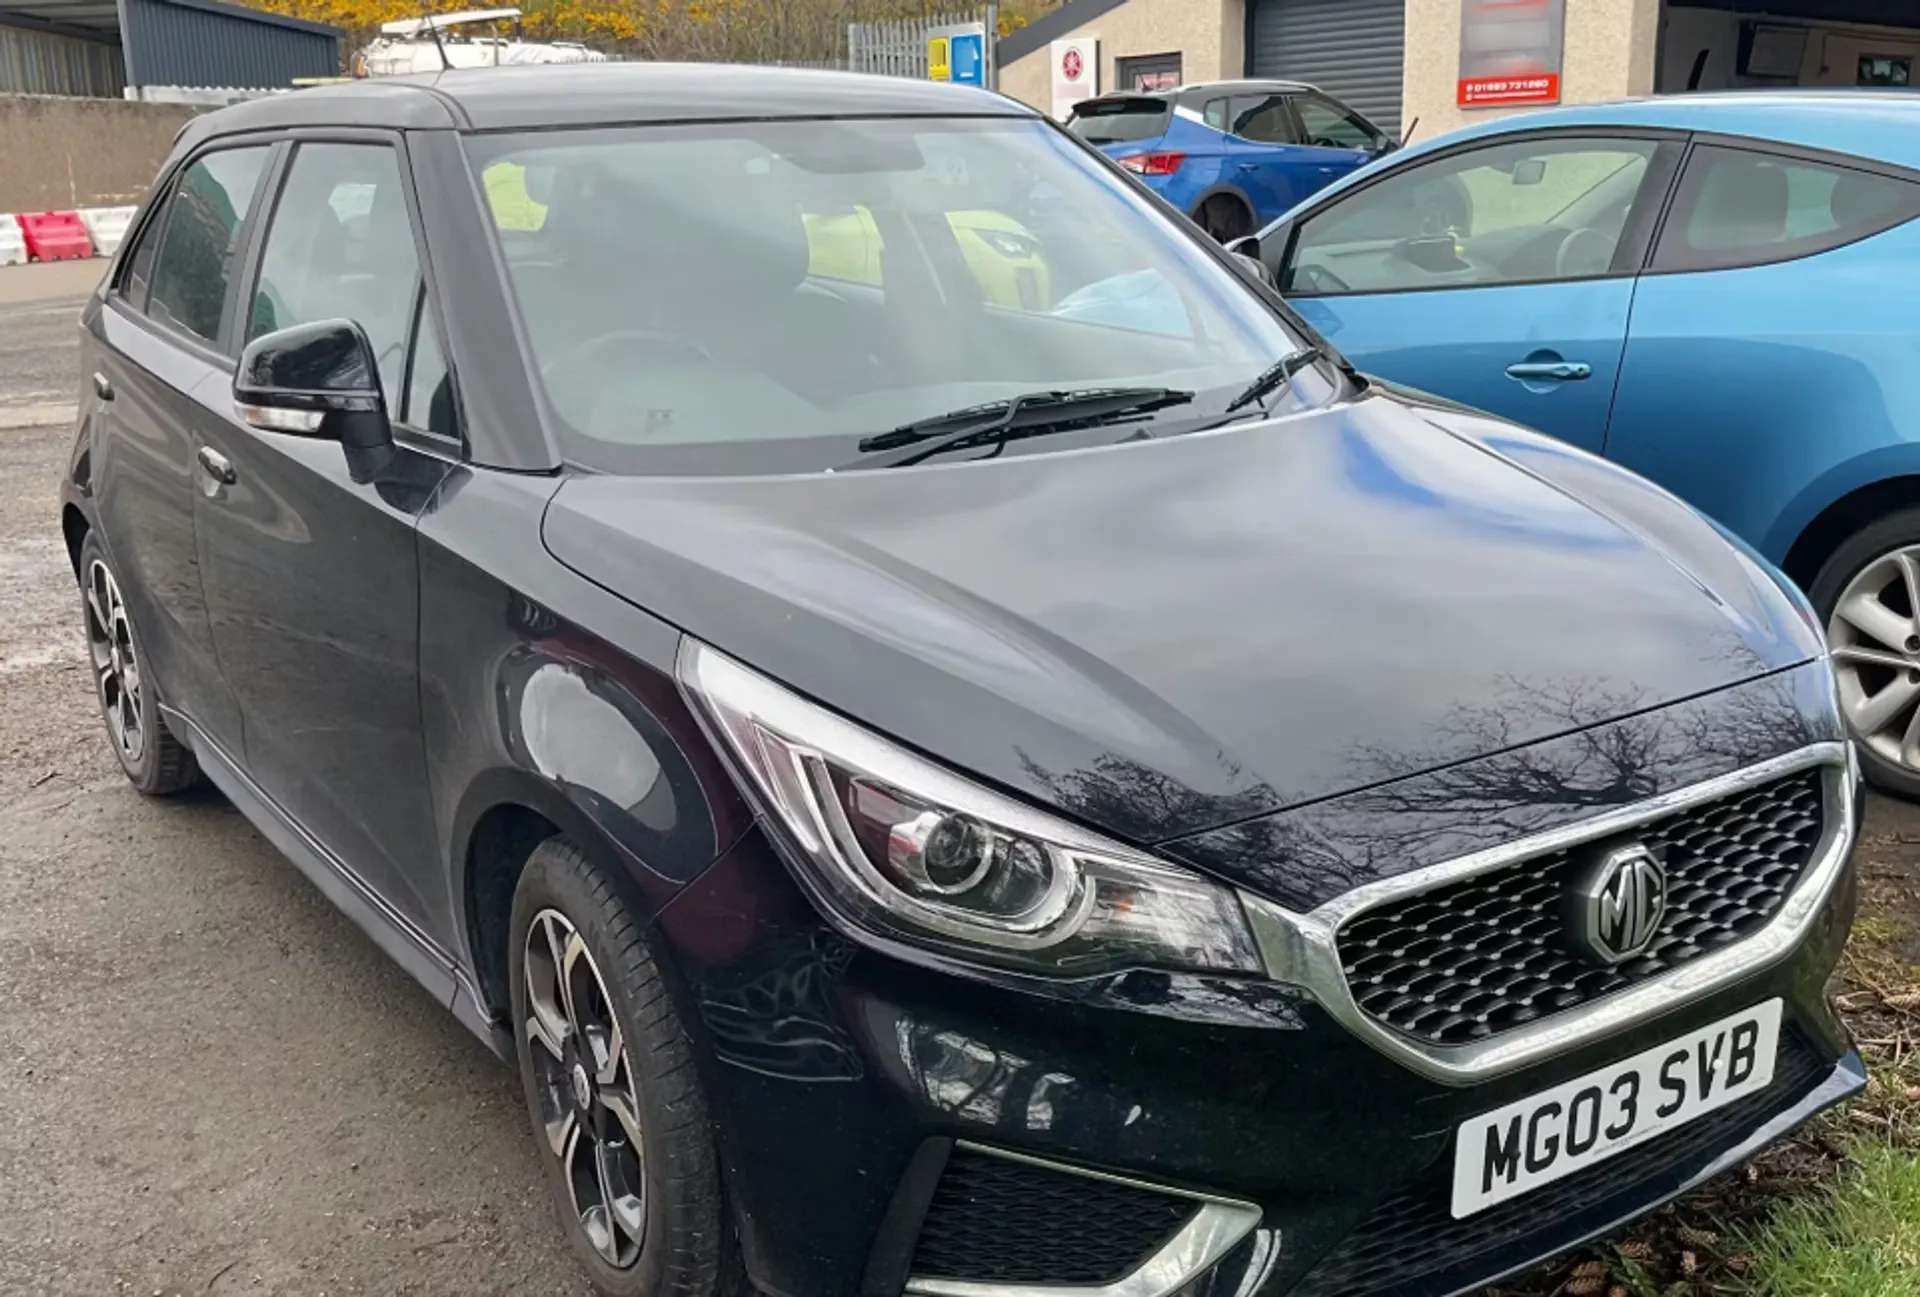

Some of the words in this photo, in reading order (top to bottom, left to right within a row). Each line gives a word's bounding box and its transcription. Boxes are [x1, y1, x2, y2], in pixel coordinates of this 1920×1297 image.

[1600, 859, 1662, 952] MG
[1481, 1070, 1641, 1195] MG03
[1655, 1018, 1760, 1119] SVB
